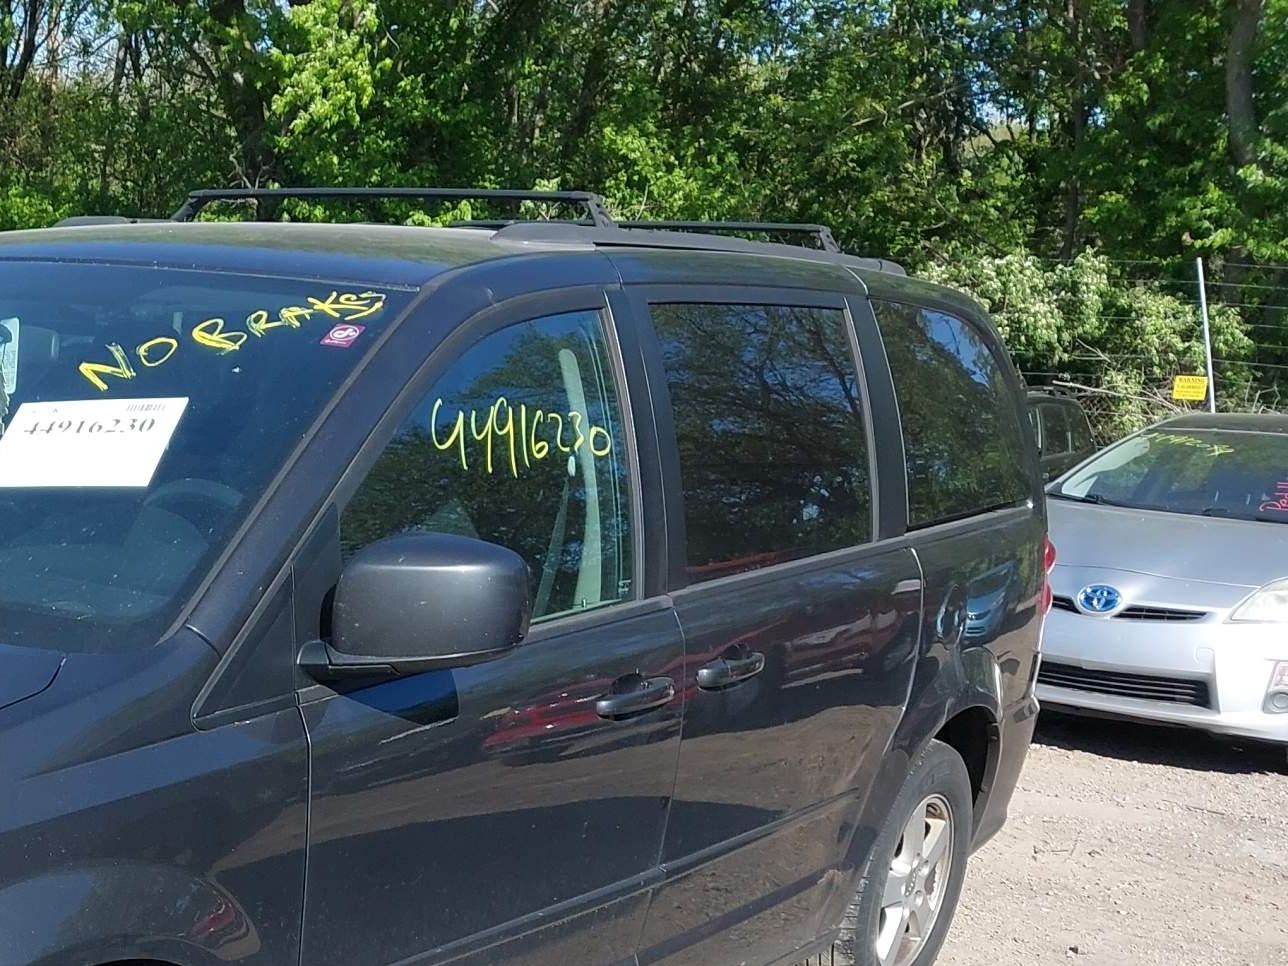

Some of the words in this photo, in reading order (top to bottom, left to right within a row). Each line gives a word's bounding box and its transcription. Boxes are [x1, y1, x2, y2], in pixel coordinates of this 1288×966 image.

[78, 336, 178, 391] NO
[23, 418, 155, 435] 44916230
[431, 396, 612, 479] 44916230
